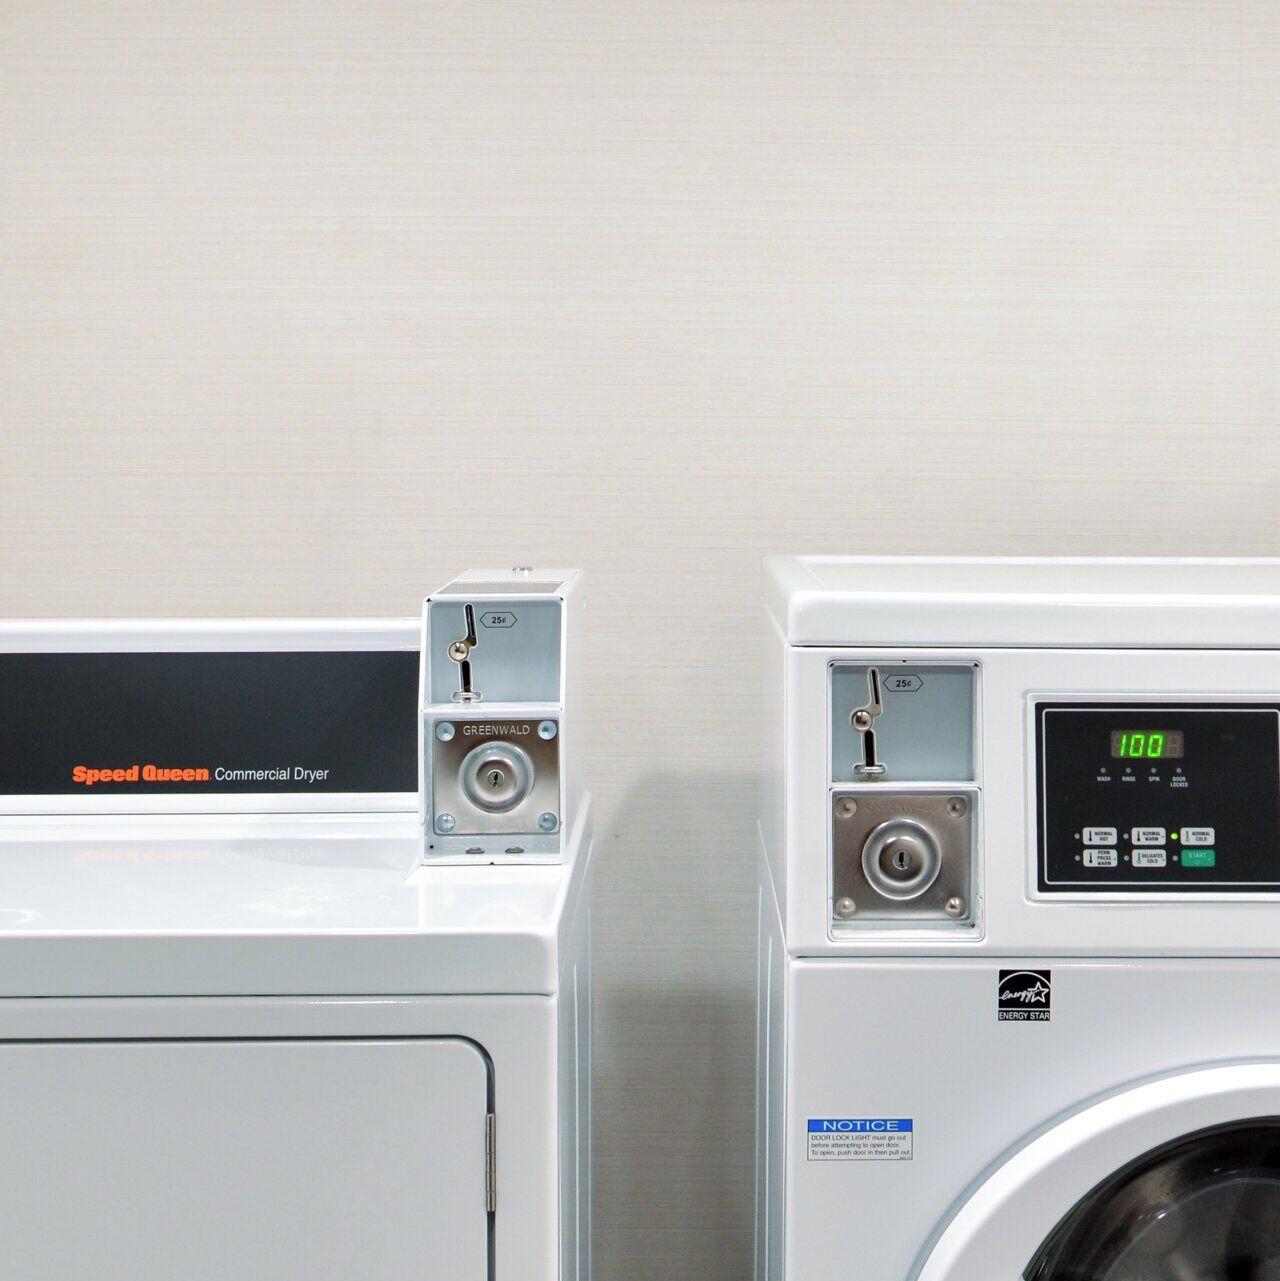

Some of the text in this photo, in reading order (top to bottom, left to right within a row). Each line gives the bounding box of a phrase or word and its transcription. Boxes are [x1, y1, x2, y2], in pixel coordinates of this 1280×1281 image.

[492, 616, 506, 624] 25¢
[896, 680, 912, 688] 25¢
[463, 725, 530, 735] GREENWALD
[72, 765, 329, 785] Speed Queen Commercial Dryer
[823, 1121, 899, 1131] NOTICE
